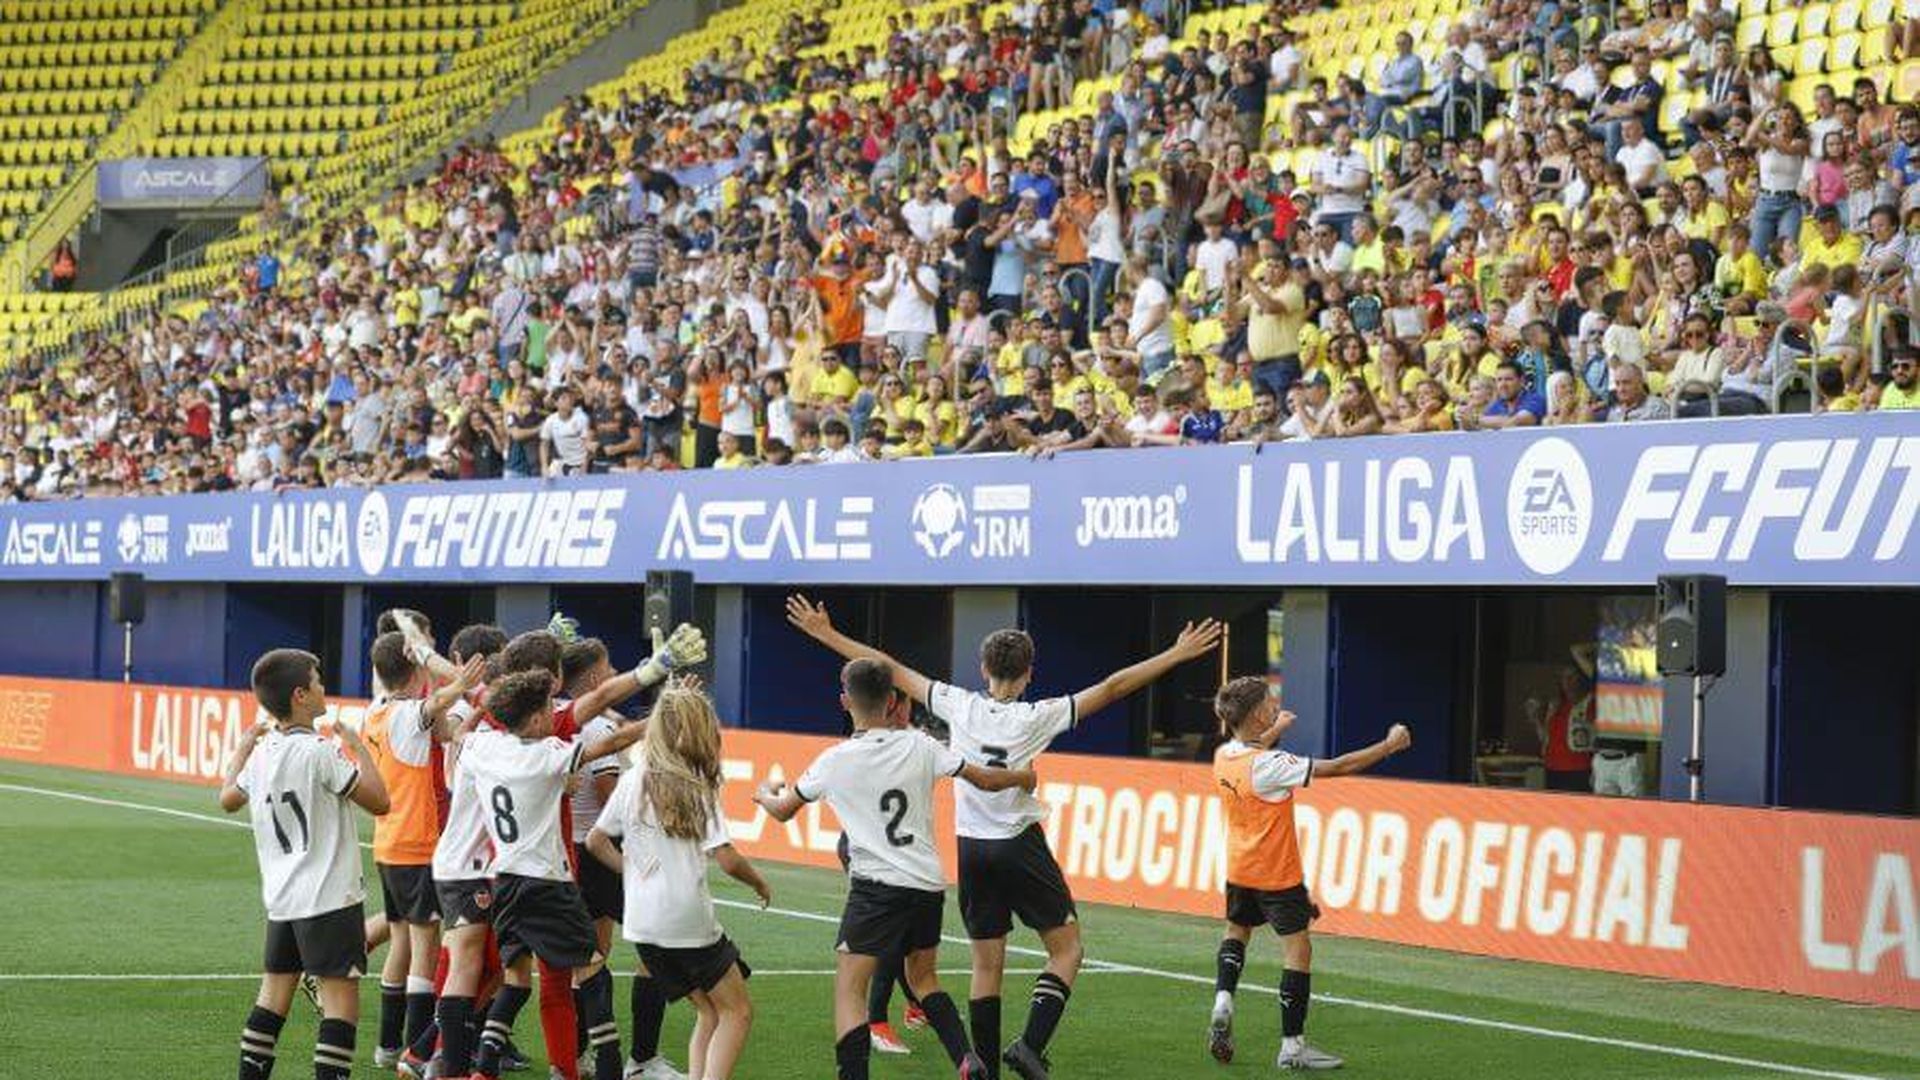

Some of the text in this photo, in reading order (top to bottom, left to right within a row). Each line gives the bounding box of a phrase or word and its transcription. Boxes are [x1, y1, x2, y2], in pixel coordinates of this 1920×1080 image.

[1237, 456, 1486, 562] LALIGA
[1523, 469, 1576, 512] EA
[3, 517, 101, 564] ASCALE
[251, 501, 349, 567] LALIGA
[657, 492, 873, 559] ASCALE
[971, 516, 1030, 558] JRM
[1521, 515, 1578, 535] SPORTS
[131, 692, 243, 779] LALIGA
[266, 790, 309, 854] 11
[492, 785, 519, 844] 8
[880, 789, 914, 846] 2
[1417, 817, 1690, 950] OFICIAL
[1803, 846, 1920, 981] LA
